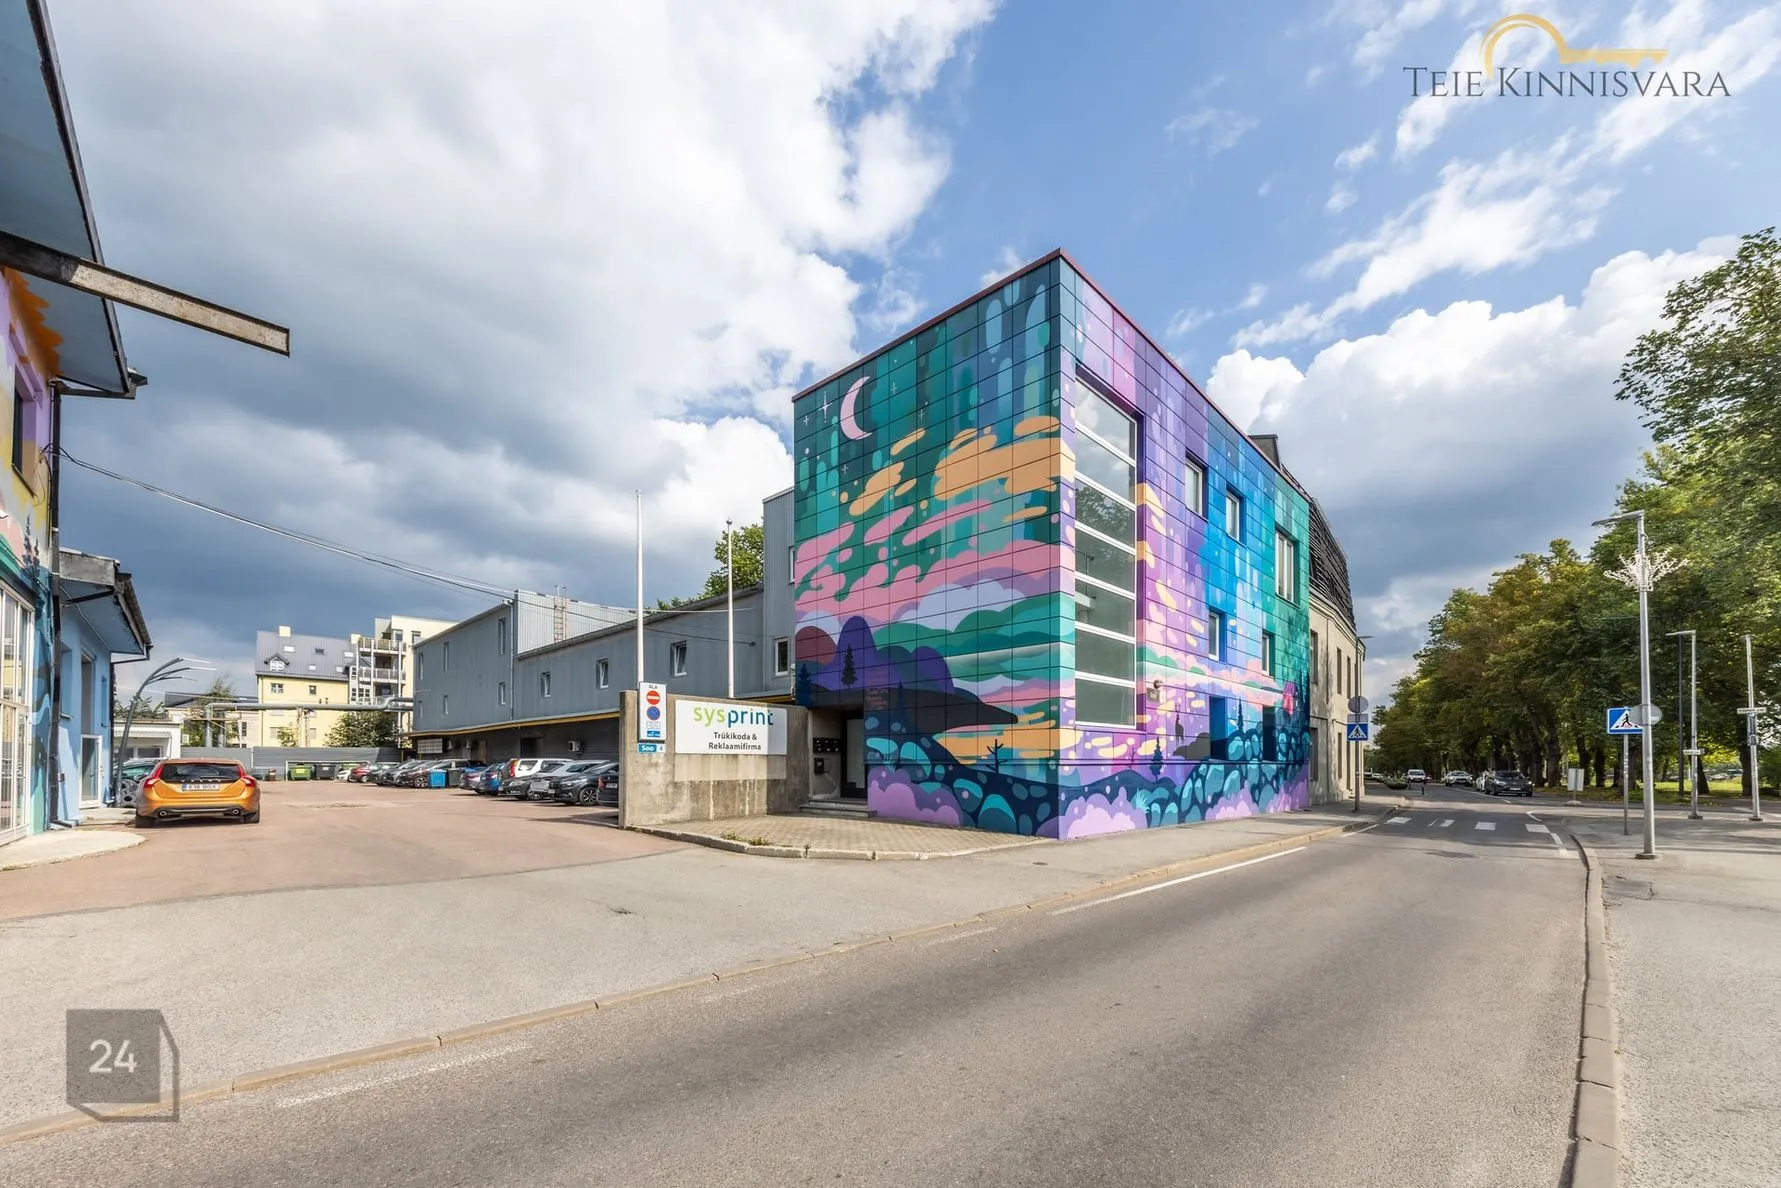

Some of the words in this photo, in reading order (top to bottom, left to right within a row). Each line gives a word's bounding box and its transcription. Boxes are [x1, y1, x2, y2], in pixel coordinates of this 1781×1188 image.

[693, 706, 774, 728] sysprint
[713, 731, 751, 740] Trükikoda
[752, 733, 758, 741] &
[641, 744, 655, 752] Soo
[708, 741, 762, 751] Reklaamifirma
